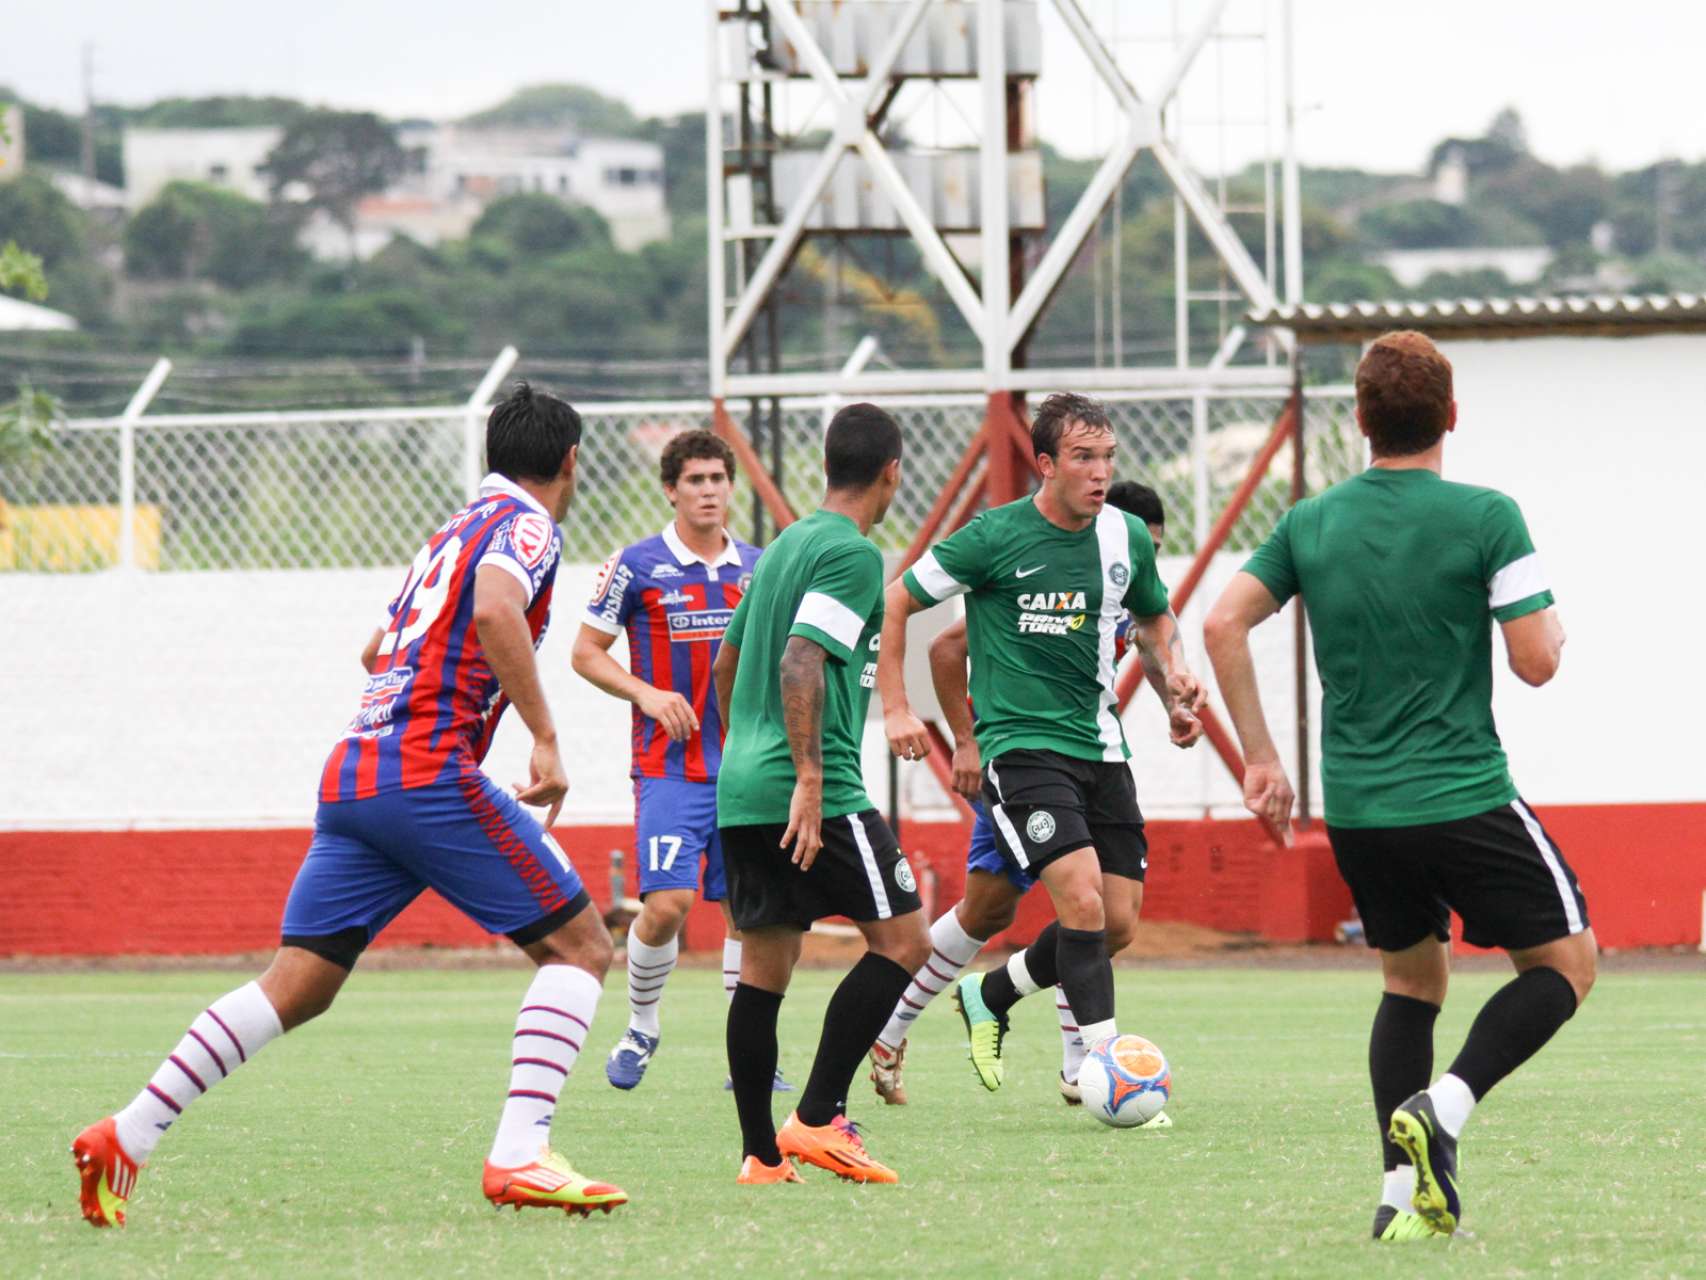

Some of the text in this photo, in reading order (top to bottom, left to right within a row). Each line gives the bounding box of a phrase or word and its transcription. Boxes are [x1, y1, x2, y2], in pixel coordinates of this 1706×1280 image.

[519, 518, 546, 558] KIA
[1017, 592, 1087, 610] CAIXA
[648, 835, 682, 871] 17
